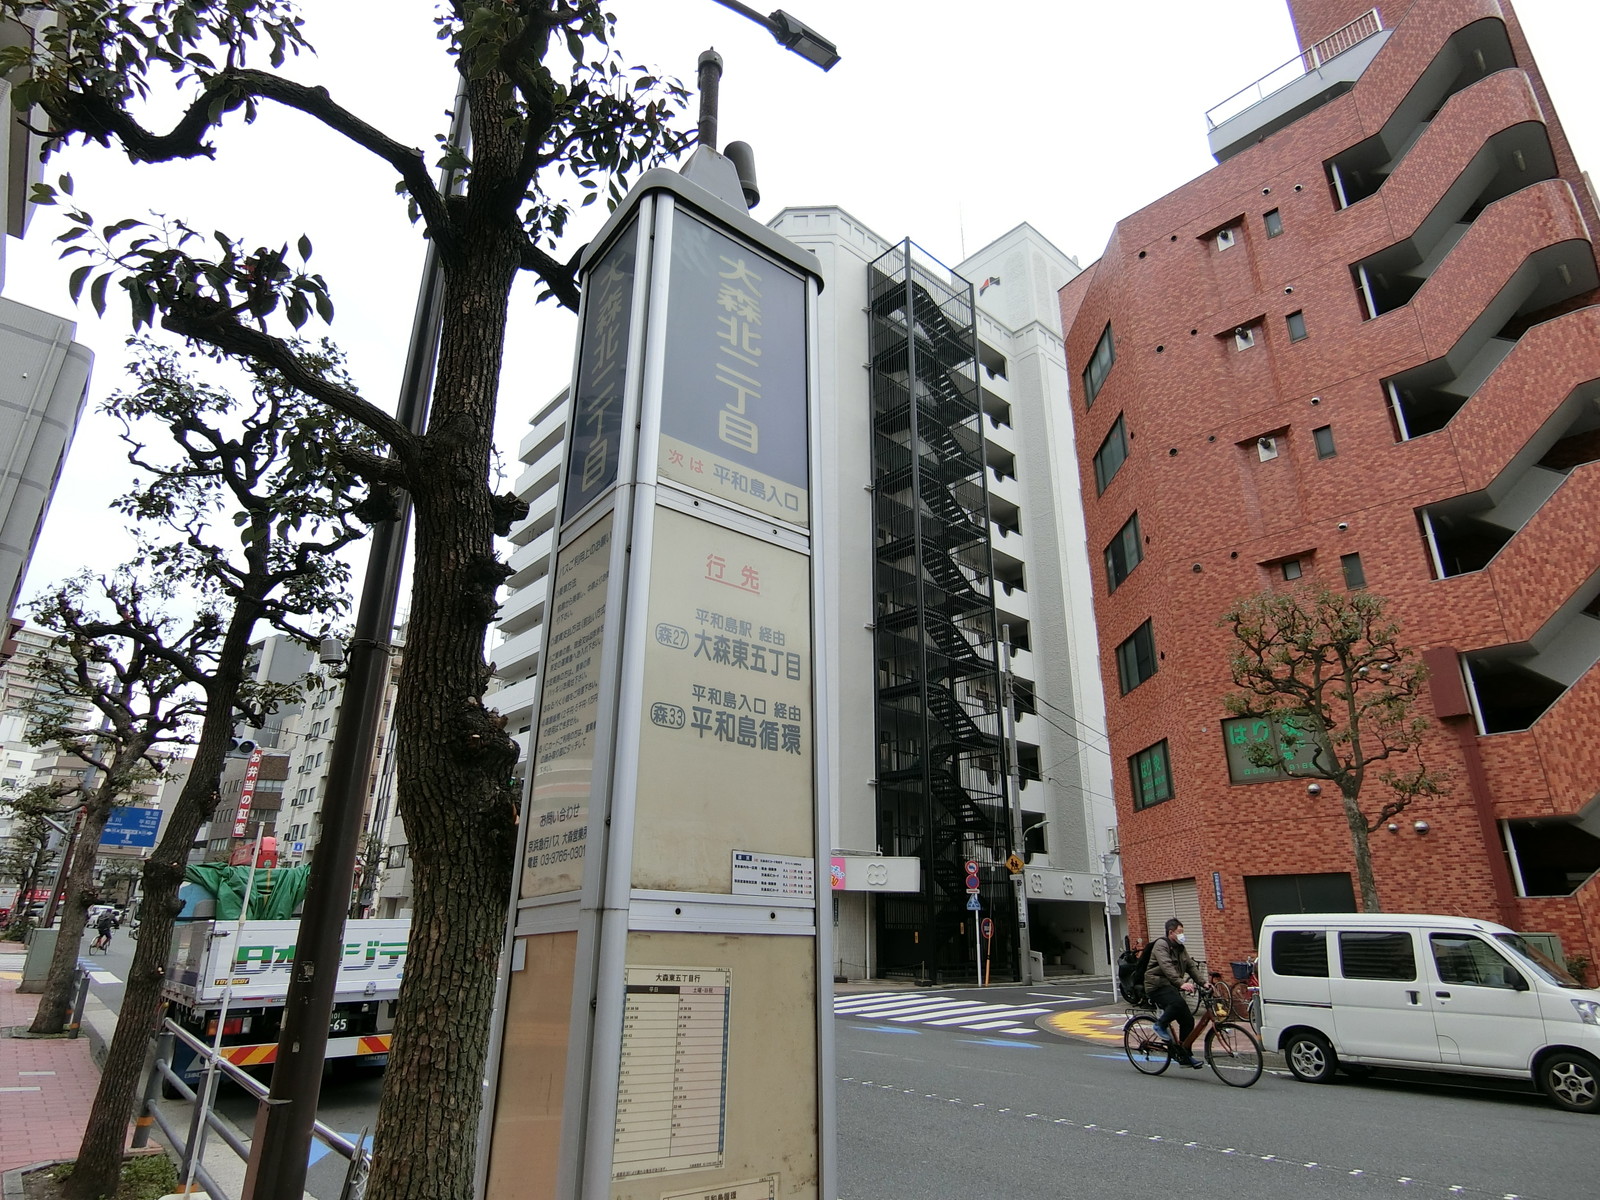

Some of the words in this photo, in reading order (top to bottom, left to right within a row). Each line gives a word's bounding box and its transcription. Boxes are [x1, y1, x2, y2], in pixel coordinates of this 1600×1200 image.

[668, 449, 703, 474] 次は
[712, 462, 799, 512] 平和島入口
[695, 608, 753, 641] 平和島駅
[758, 625, 786, 648] 経由
[693, 629, 801, 682] 大森東五丁目
[692, 684, 766, 724] 平和島入口
[774, 702, 801, 722] 経由
[691, 705, 801, 755] 平和島循環
[1229, 721, 1270, 745] はり
[539, 803, 580, 828] お問い合わせ
[528, 834, 560, 854] 京浜急行バス
[527, 855, 539, 869] 電話
[655, 974, 701, 983] 大森東五丁目行
